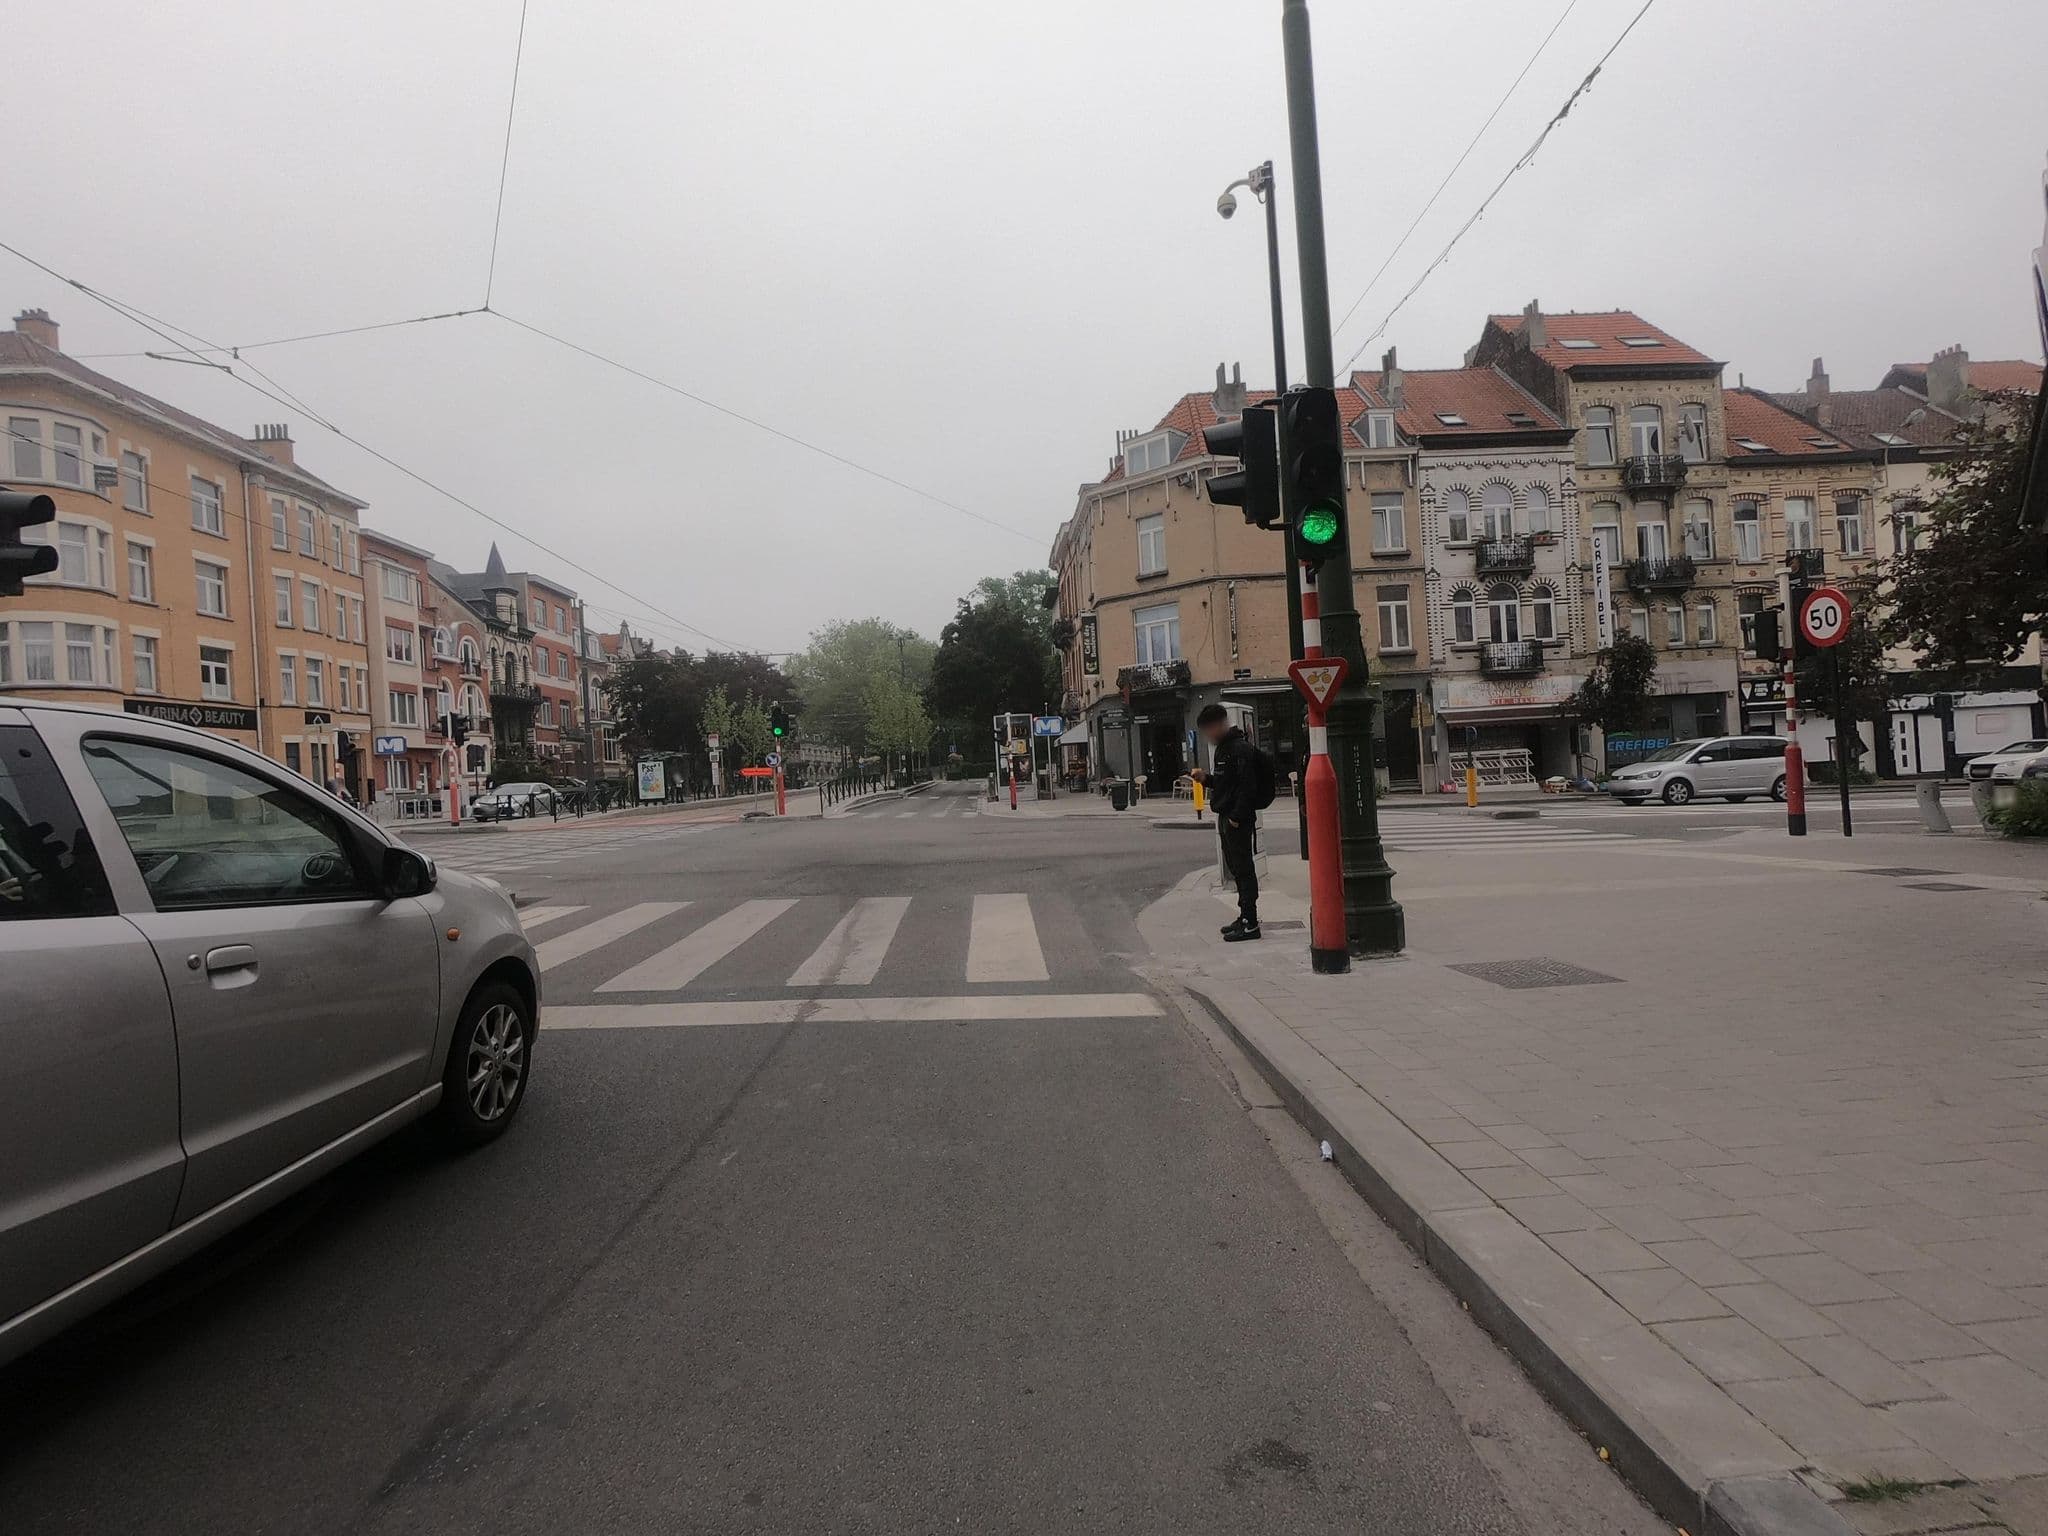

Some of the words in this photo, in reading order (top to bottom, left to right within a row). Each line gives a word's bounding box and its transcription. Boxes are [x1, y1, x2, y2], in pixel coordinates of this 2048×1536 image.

[1594, 538, 1605, 638] CREFIBEL
[1810, 606, 1837, 630] 50
[137, 704, 189, 722] MARINA
[204, 710, 245, 725] BEAUTY
[377, 738, 404, 753] M
